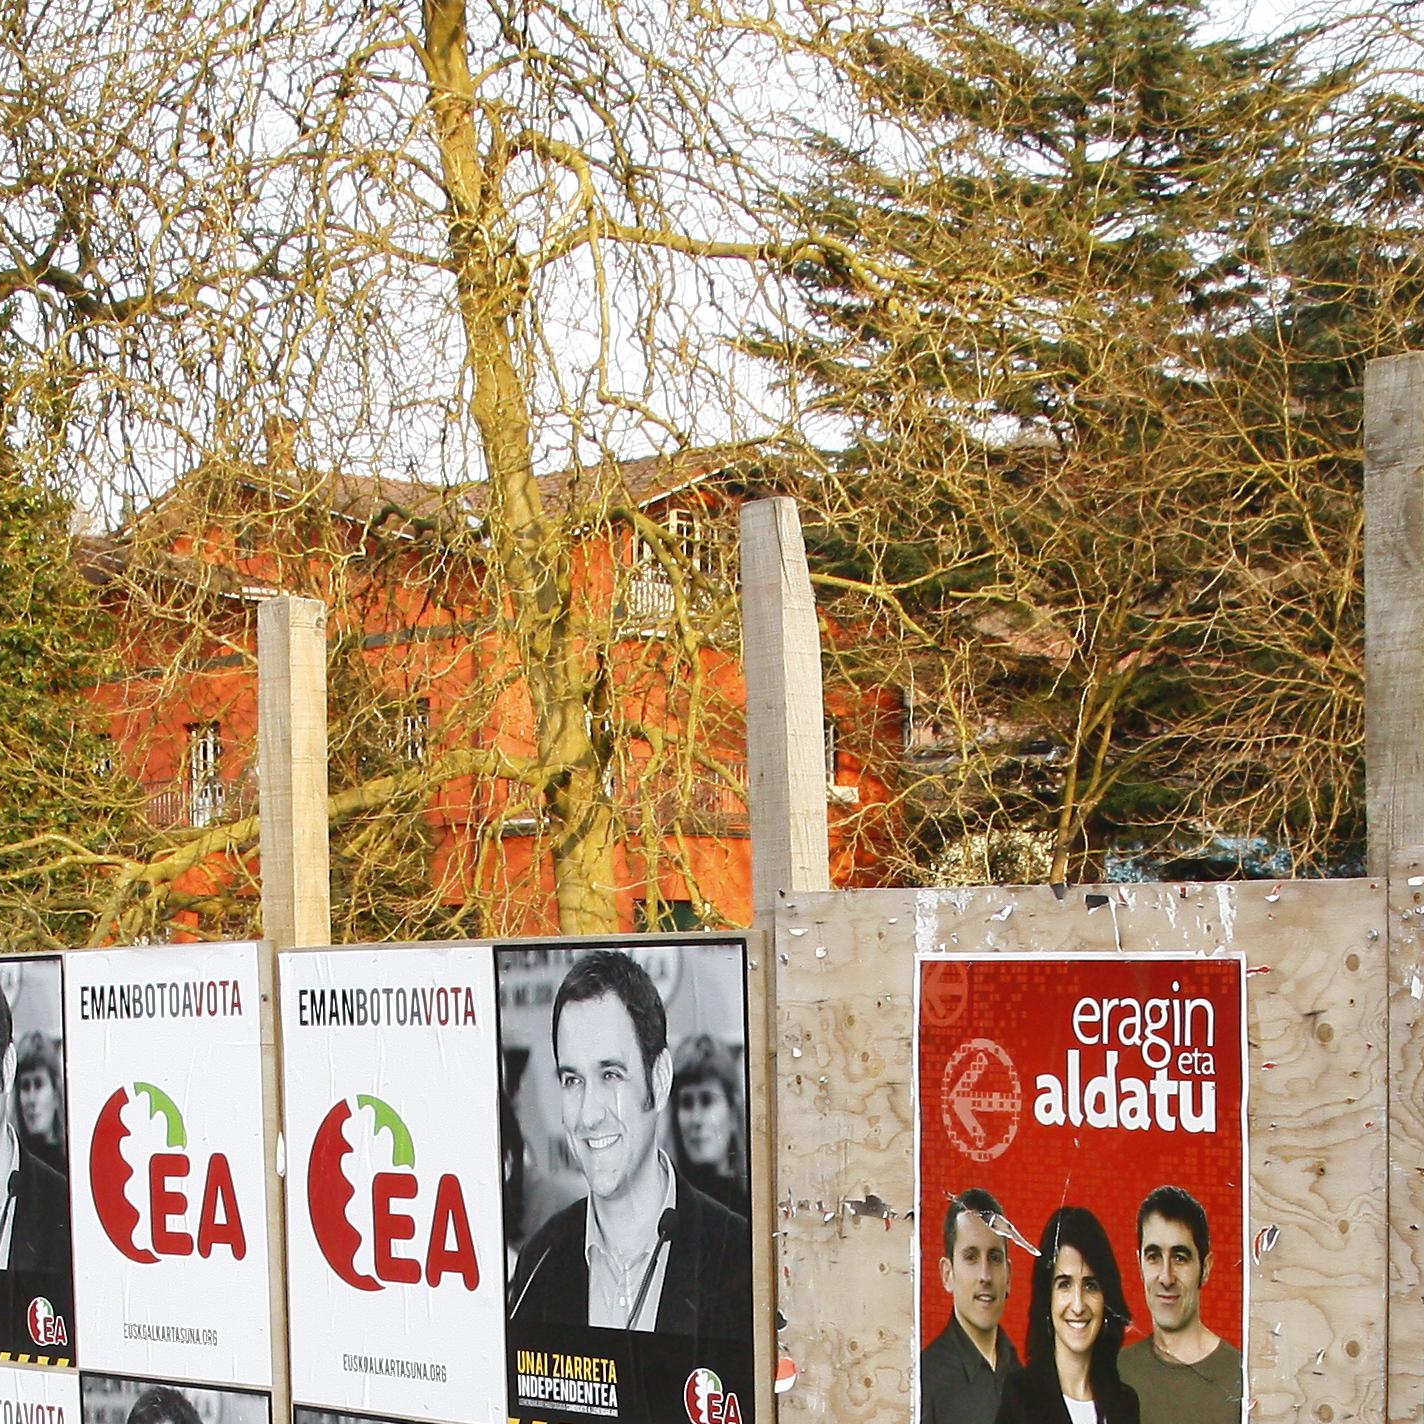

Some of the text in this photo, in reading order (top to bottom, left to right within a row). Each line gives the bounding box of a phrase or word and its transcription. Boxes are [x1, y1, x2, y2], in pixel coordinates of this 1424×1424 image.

[1072, 981, 1214, 1069] eragin
[1178, 1048, 1215, 1075] eta
[1033, 1049, 1216, 1133] aldatu
[149, 1152, 247, 1261] EA
[372, 1172, 481, 1292] EA
[44, 1314, 68, 1345] EA
[123, 1321, 218, 1346] EUSKOALKARTASUNA.ORG
[343, 1353, 448, 1383] EUSKOALKARTASUNA.ORG
[517, 1350, 618, 1384] UNAI ZIARRETA
[517, 1375, 619, 1407] INDEPENDENTEA
